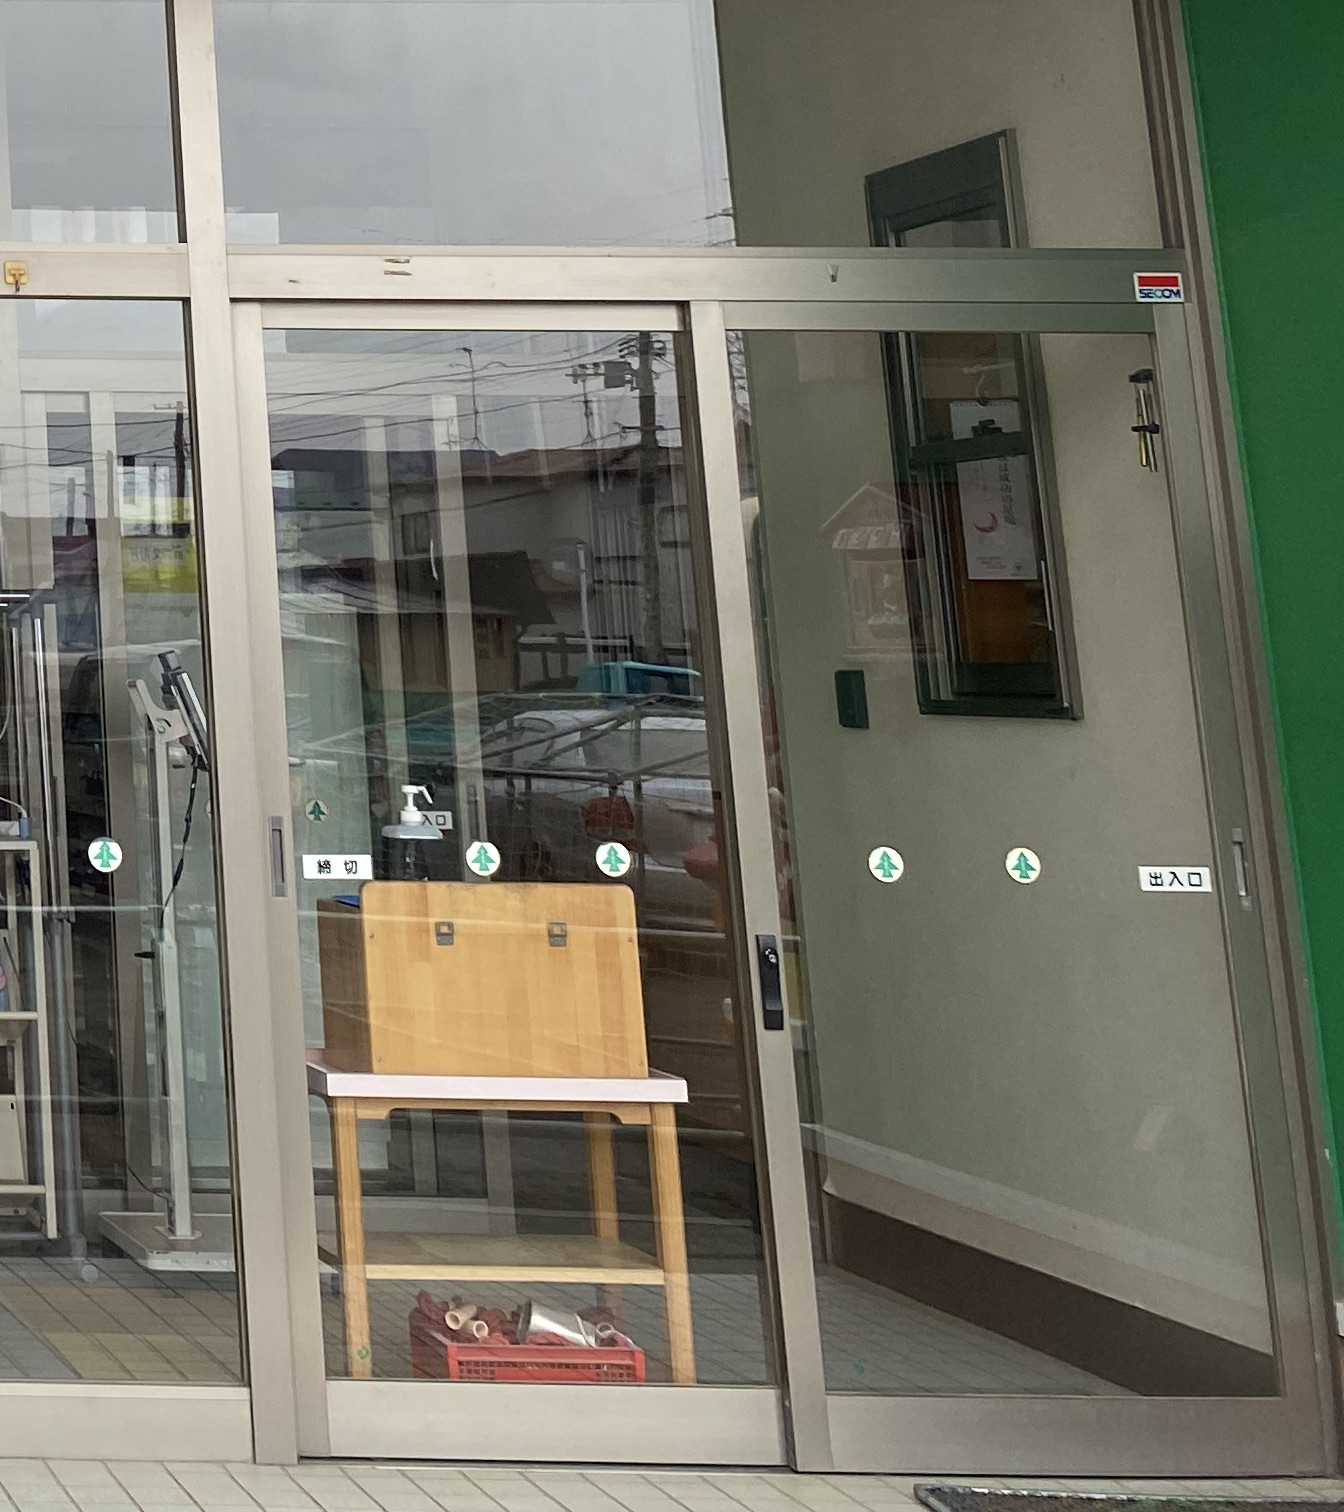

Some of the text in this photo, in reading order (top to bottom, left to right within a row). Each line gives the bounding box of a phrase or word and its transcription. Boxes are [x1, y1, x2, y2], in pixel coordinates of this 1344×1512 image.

[1138, 288, 1182, 299] SECOM
[316, 858, 358, 875] 締切
[1148, 871, 1203, 887] 出入口
